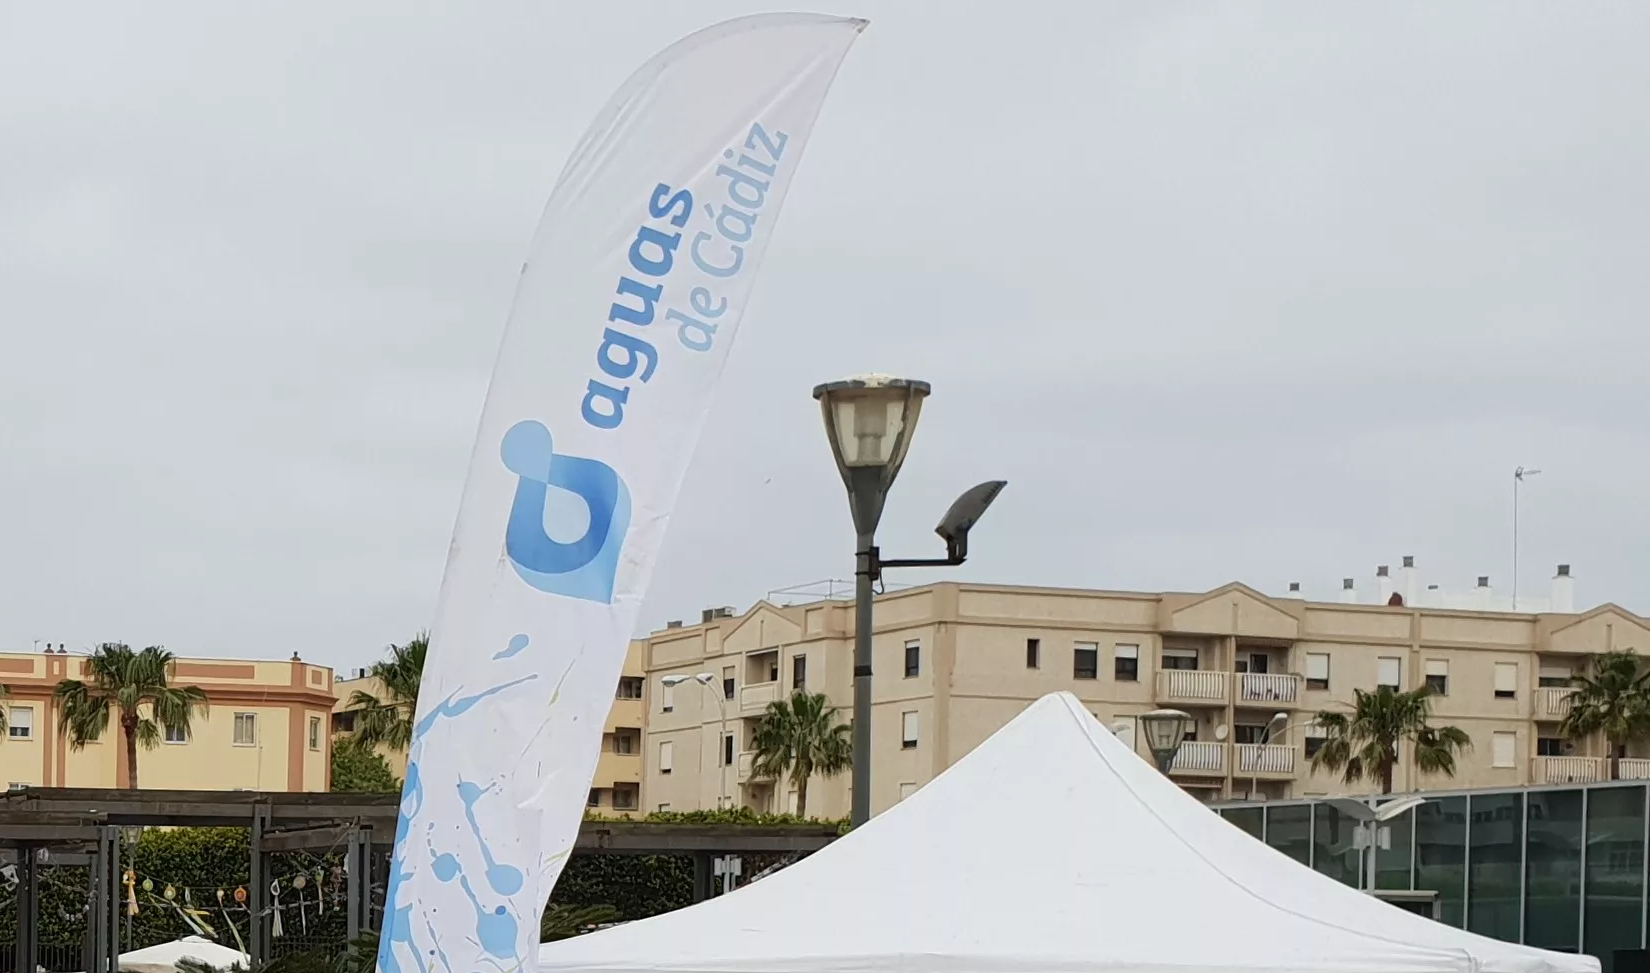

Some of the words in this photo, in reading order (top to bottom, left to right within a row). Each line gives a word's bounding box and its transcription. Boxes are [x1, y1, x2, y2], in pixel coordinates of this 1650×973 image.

[690, 122, 789, 278] Cádiz
[581, 182, 693, 430] aguas
[665, 286, 728, 352] de
